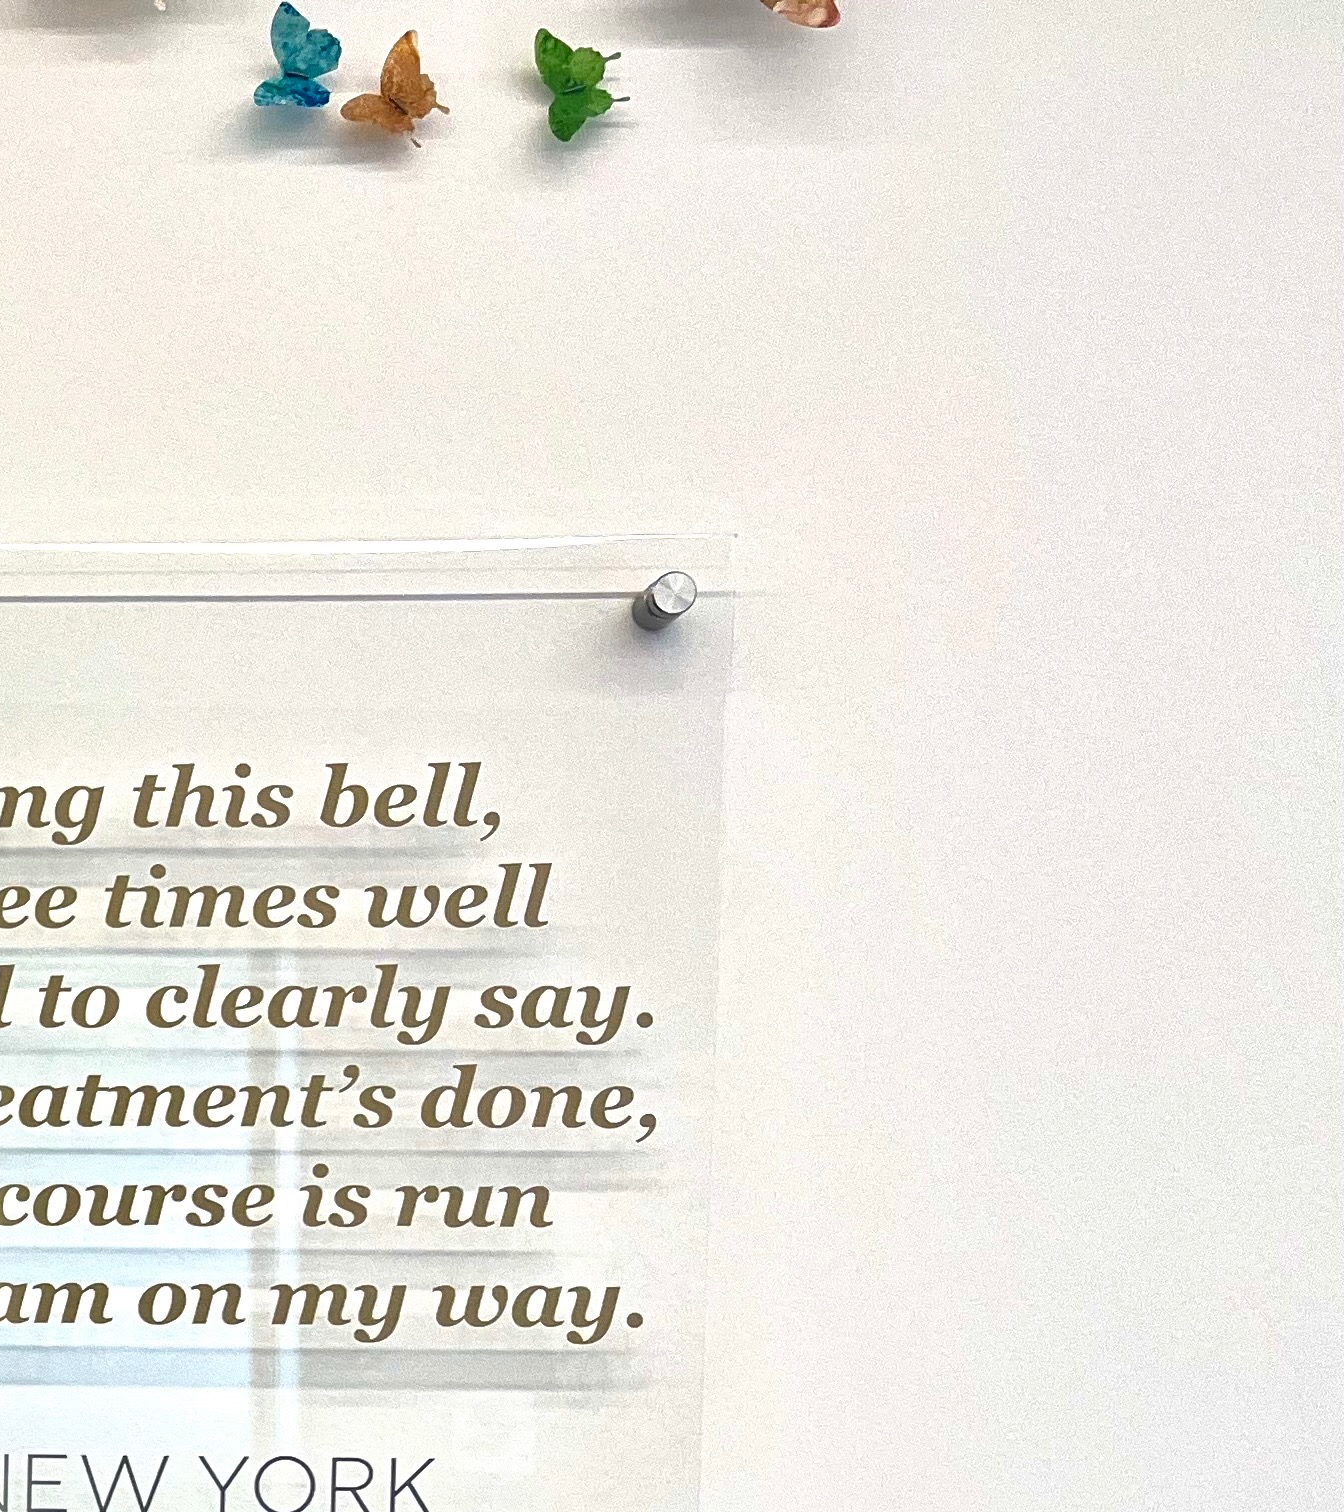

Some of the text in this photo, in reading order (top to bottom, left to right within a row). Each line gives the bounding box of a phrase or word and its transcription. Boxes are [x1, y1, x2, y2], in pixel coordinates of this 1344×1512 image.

[132, 763, 293, 829] this
[320, 762, 502, 841] bell,
[105, 864, 340, 929] times
[367, 863, 552, 929] well
[40, 975, 120, 1028] to
[146, 964, 450, 1045] clearly
[475, 985, 654, 1045] say.
[421, 1063, 658, 1143] done,
[302, 1163, 371, 1228] is
[396, 1184, 553, 1229] run
[138, 1283, 243, 1325] on
[270, 1283, 406, 1343] my
[433, 1284, 644, 1345] way.
